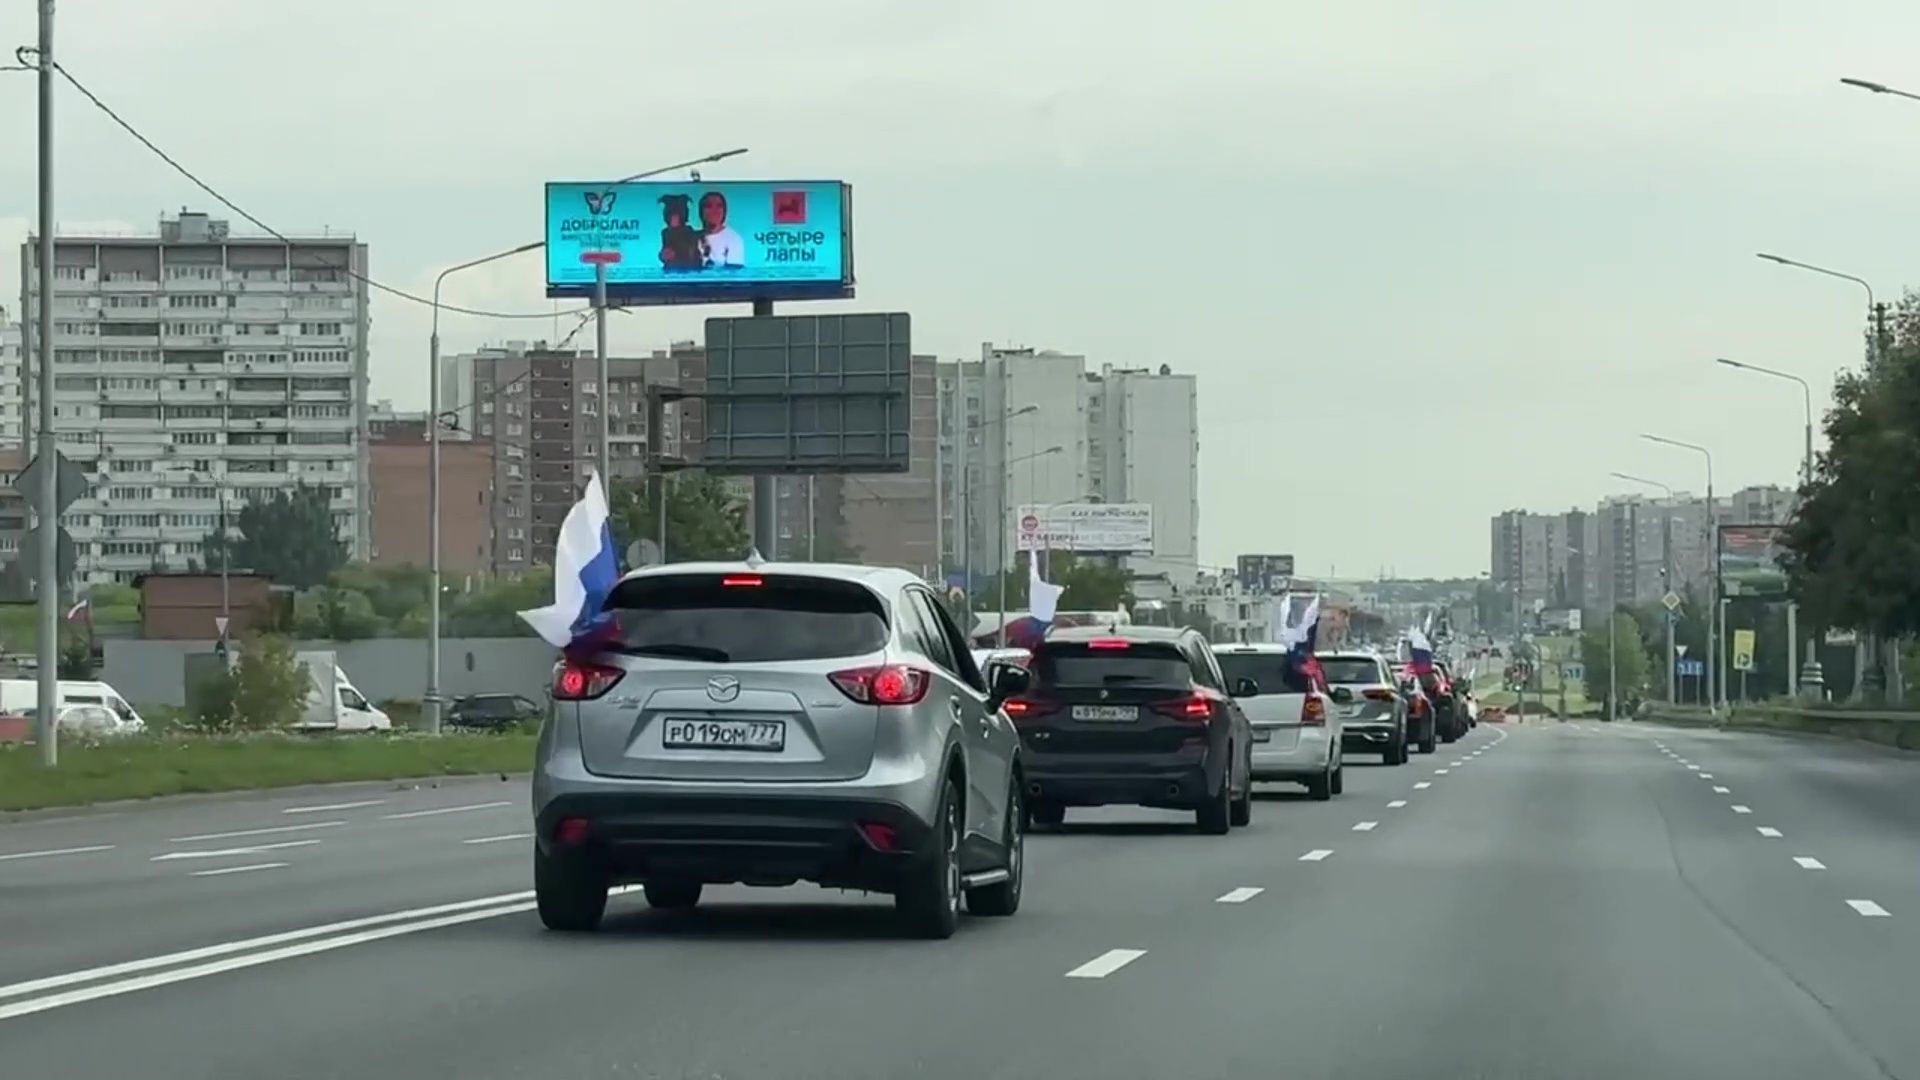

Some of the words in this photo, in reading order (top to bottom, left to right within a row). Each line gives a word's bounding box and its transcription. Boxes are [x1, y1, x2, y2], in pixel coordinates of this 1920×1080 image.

[560, 219, 640, 232] ДОБРОЛАП
[754, 231, 826, 246] четыре
[765, 248, 816, 262] лапы
